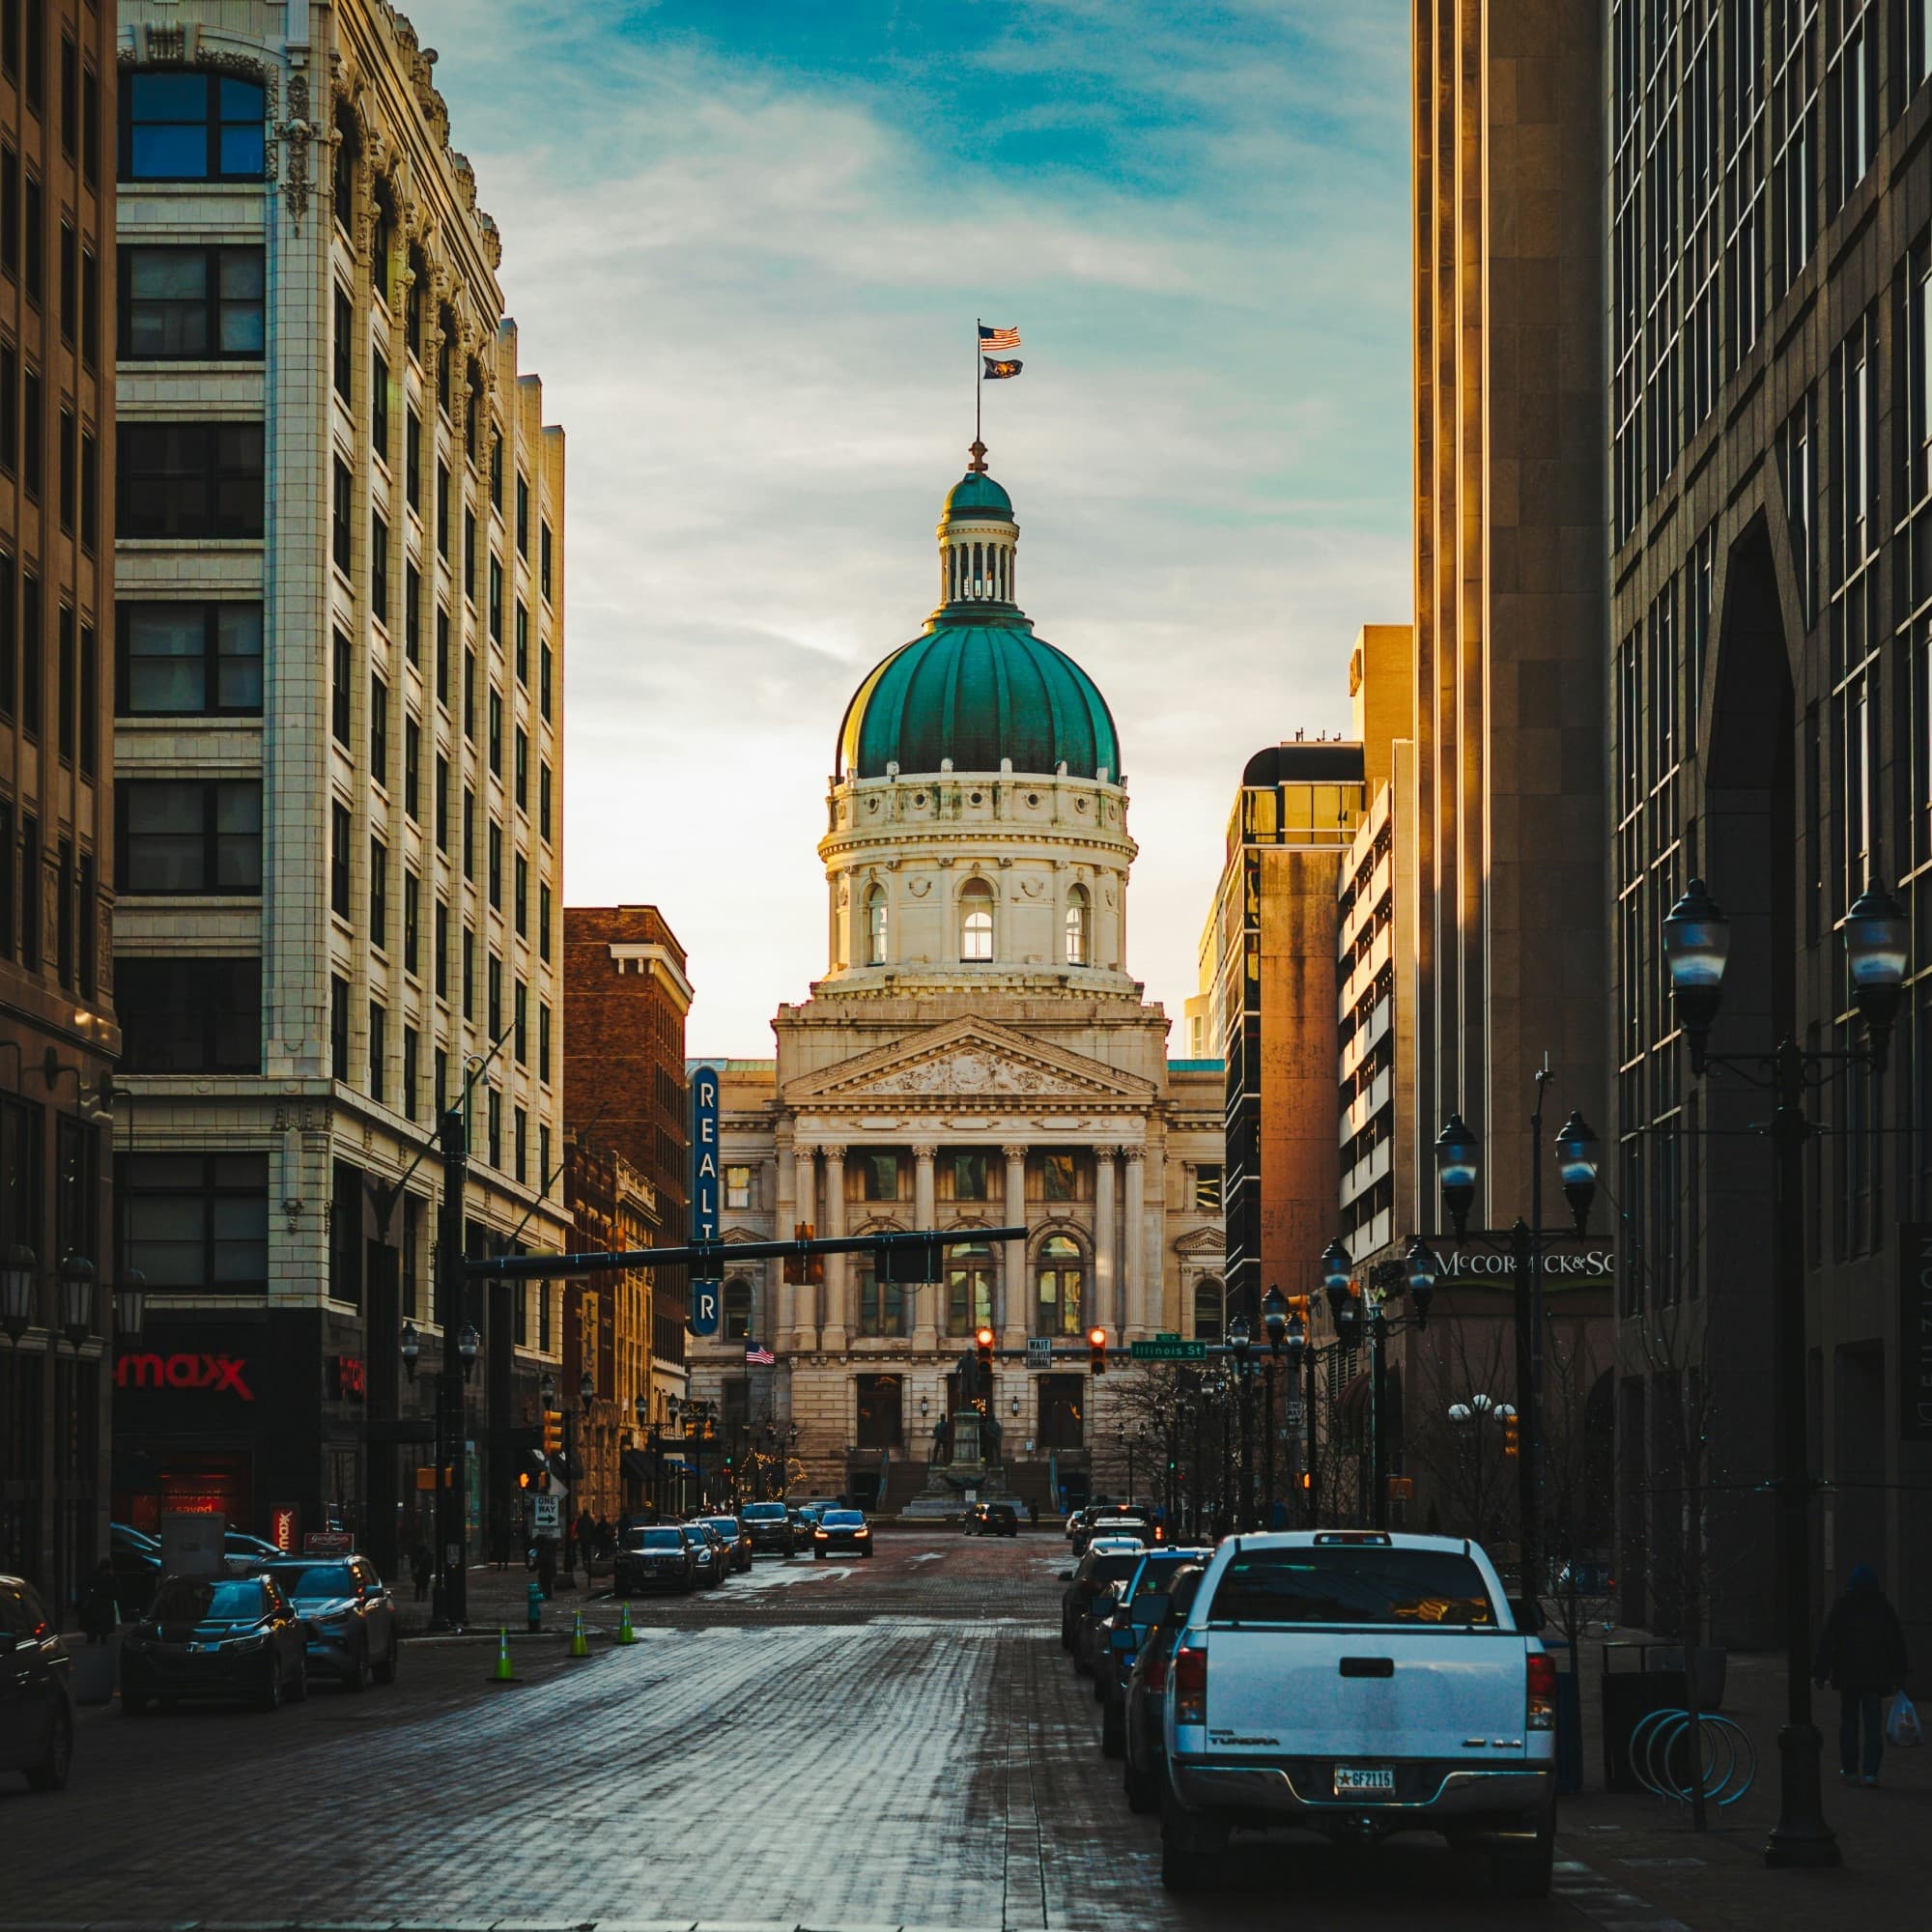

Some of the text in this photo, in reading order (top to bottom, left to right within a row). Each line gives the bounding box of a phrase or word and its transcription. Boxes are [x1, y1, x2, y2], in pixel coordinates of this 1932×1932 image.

[698, 1082, 716, 1320] REALTR
[1029, 1340, 1049, 1350] WAIT
[1136, 1345, 1201, 1355] Illinois St
